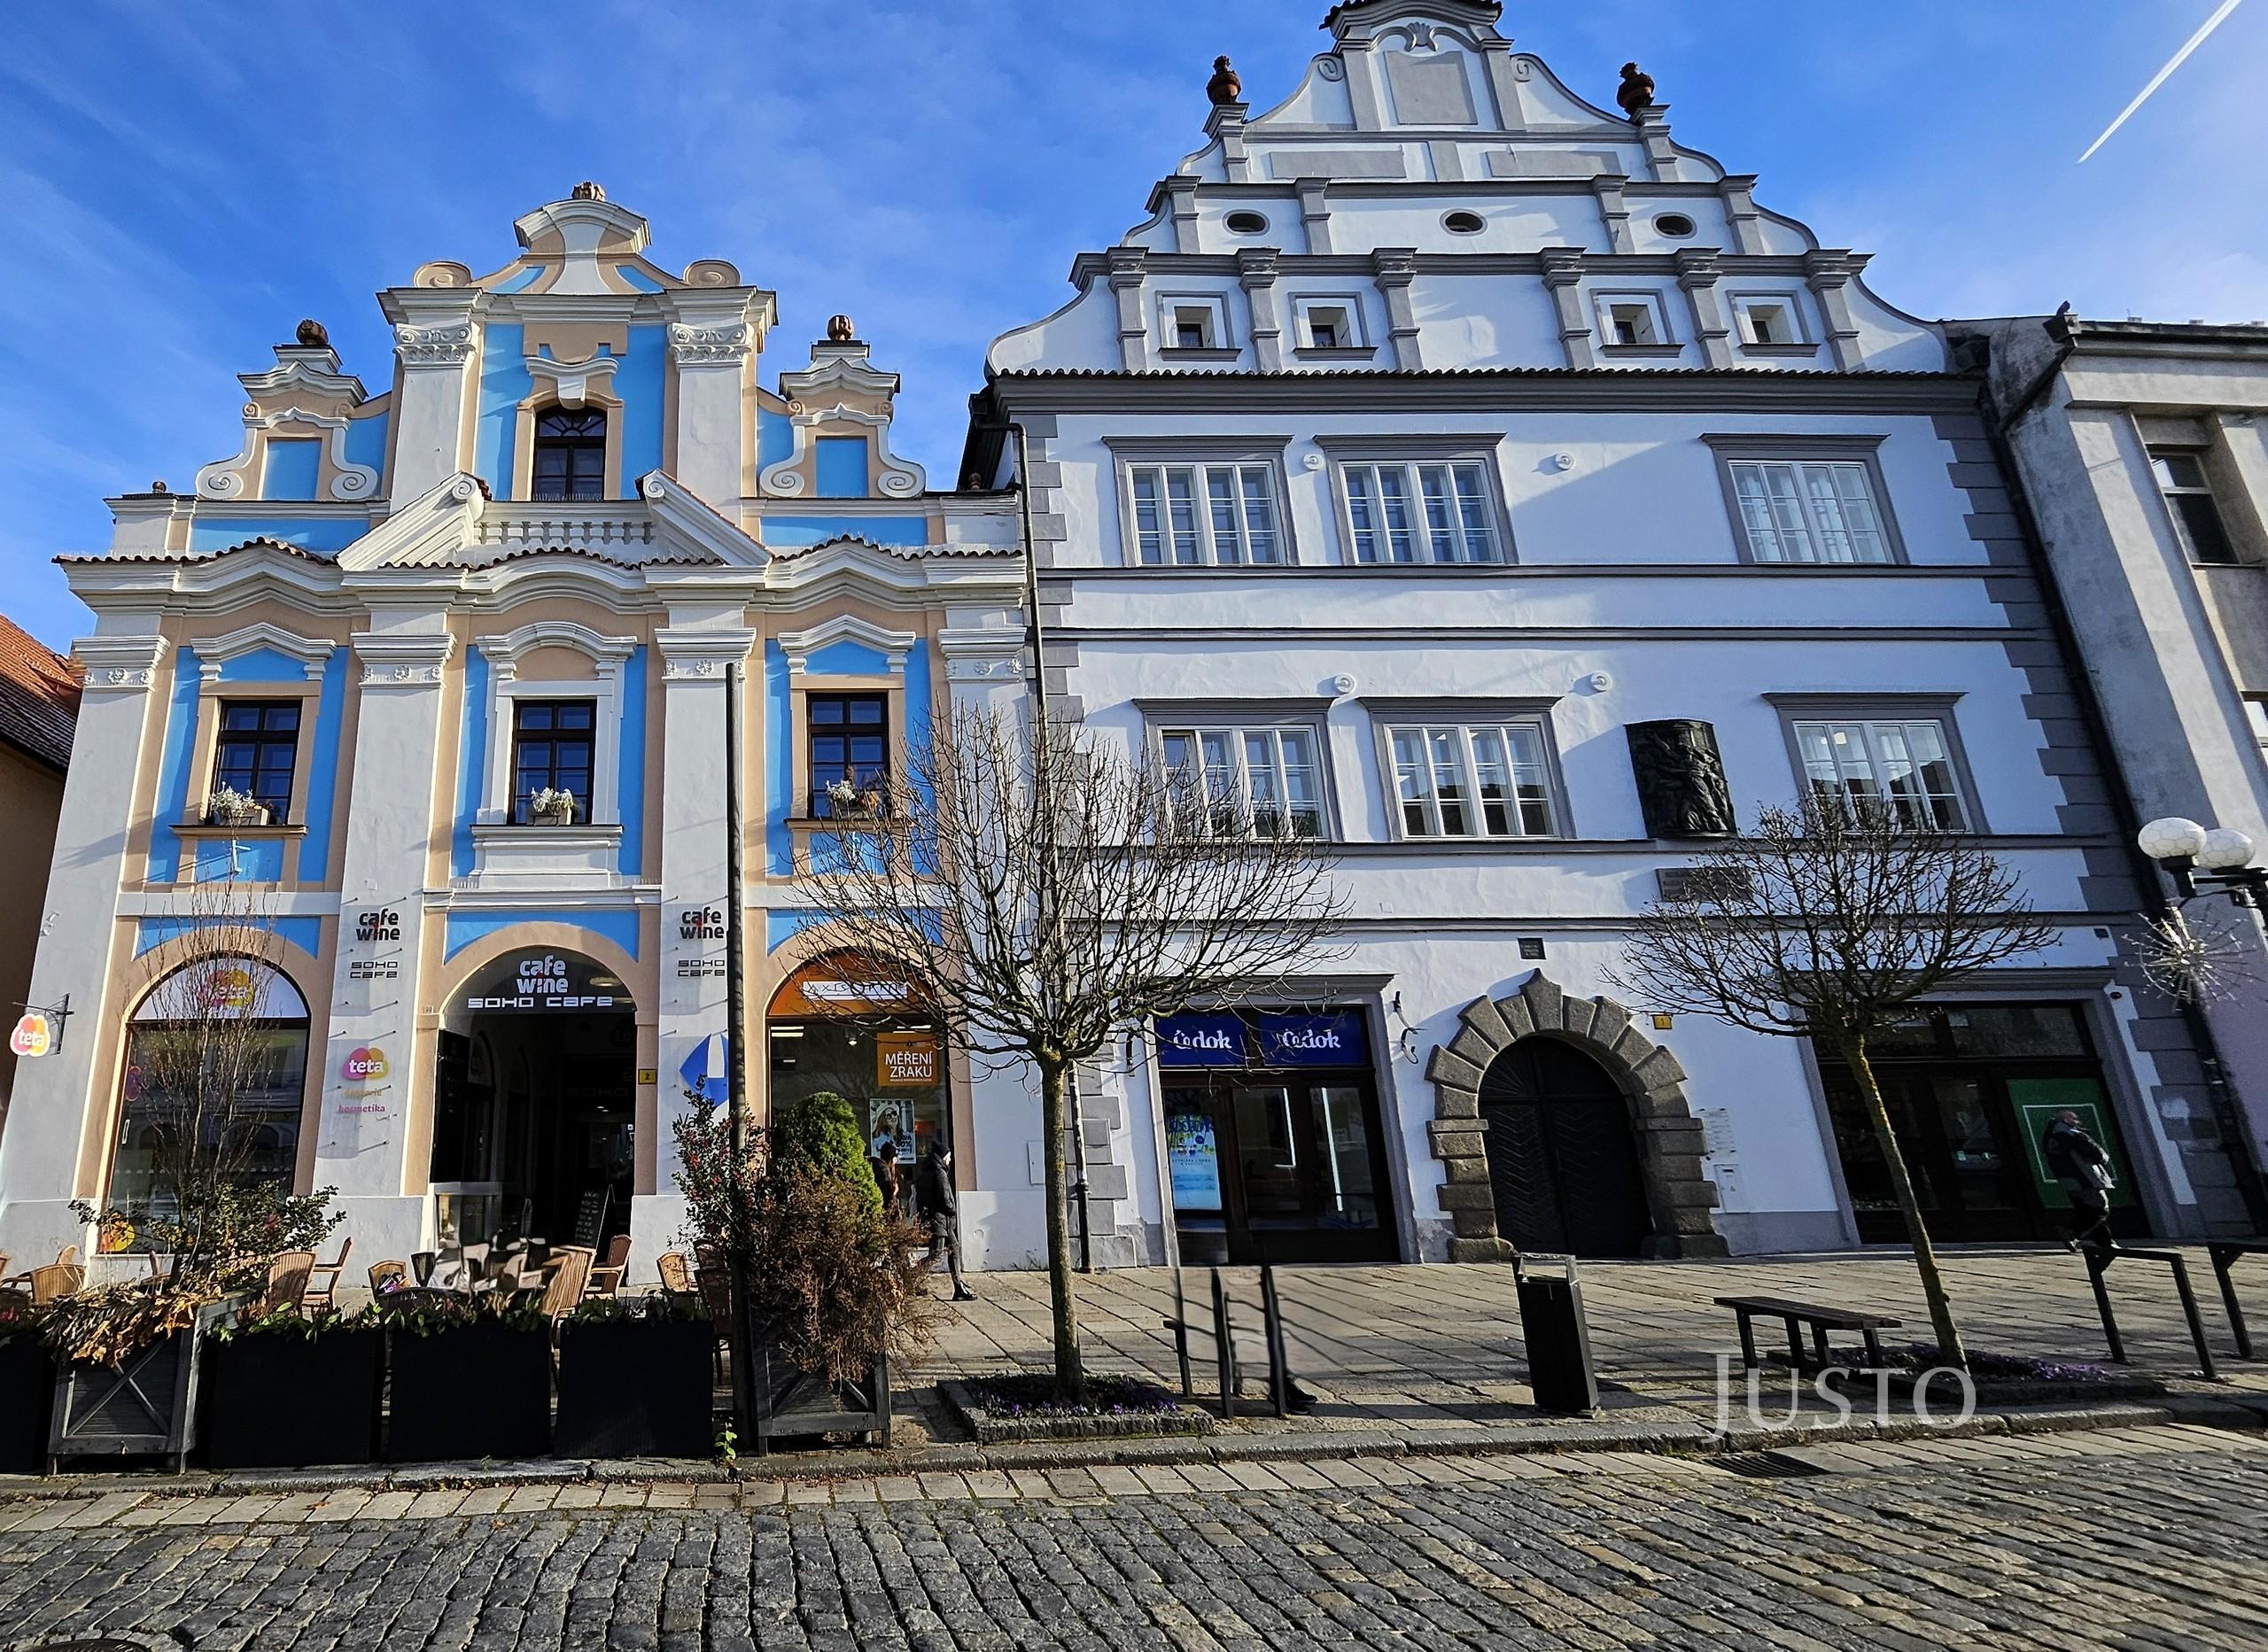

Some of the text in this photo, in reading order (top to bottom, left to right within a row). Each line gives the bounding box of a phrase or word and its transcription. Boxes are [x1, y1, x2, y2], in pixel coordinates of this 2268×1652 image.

[359, 908, 400, 926] cafe
[682, 906, 722, 924] cafe
[356, 927, 400, 941] wine
[679, 926, 725, 939] wine
[519, 955, 566, 976] cafe
[517, 977, 569, 994] wine
[468, 997, 534, 1008] SOHO
[19, 1029, 43, 1045] teta
[885, 1051, 933, 1065] MĚŘENÍ
[348, 1059, 384, 1074] teta
[889, 1066, 932, 1078] ZRAKU
[339, 1104, 385, 1113] kosmetika
